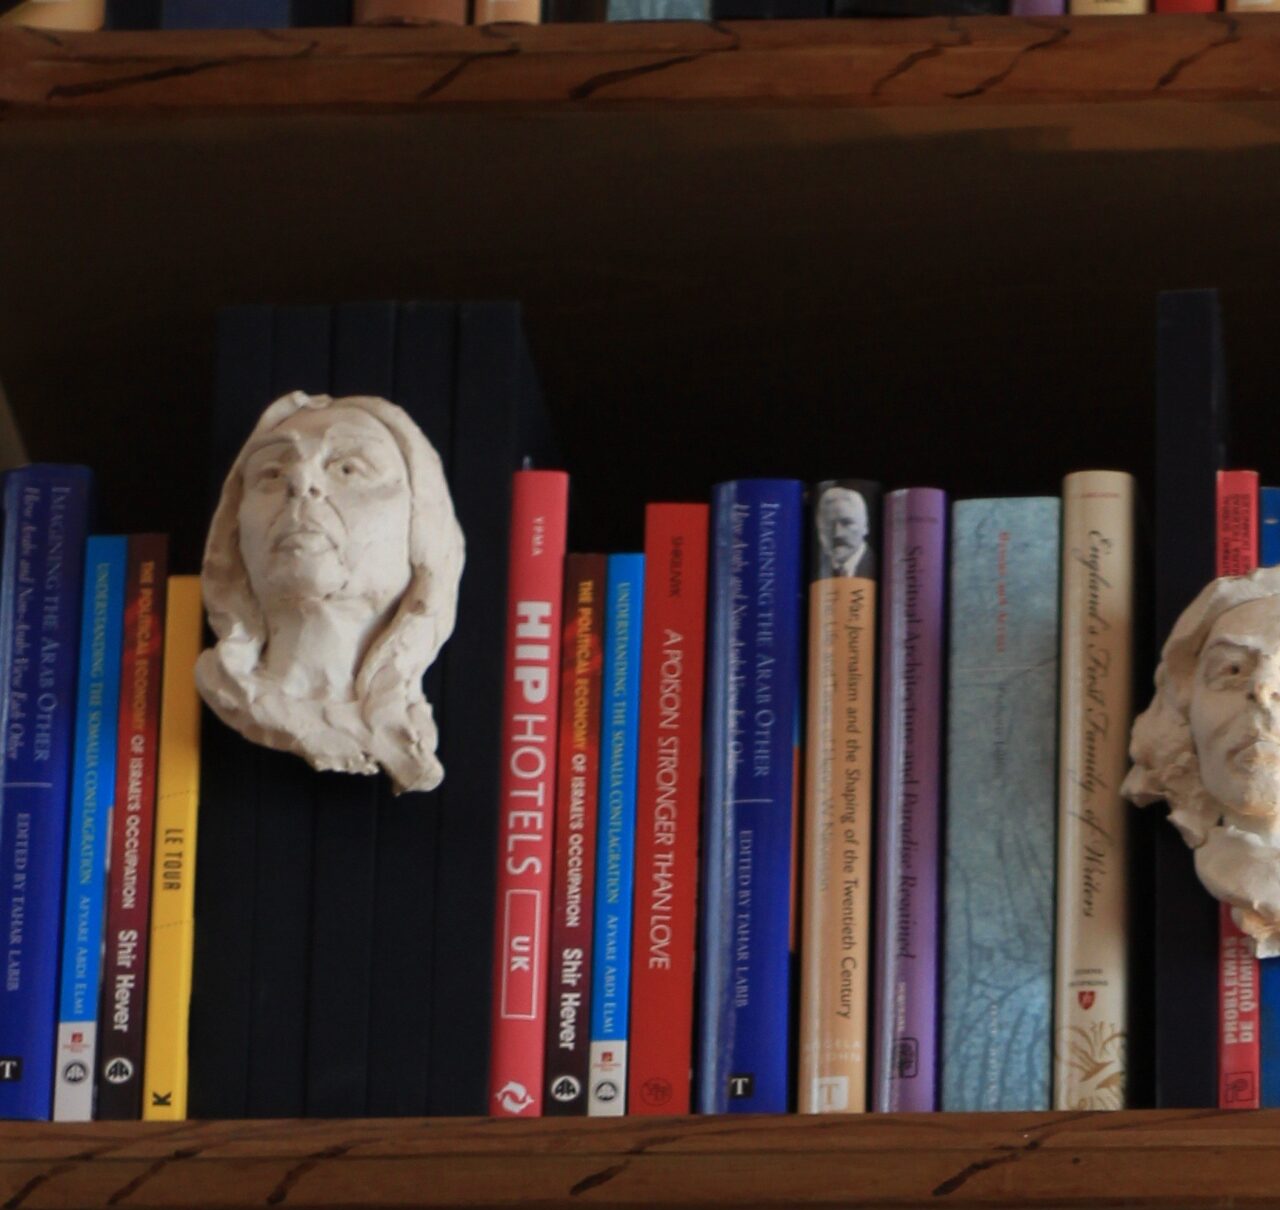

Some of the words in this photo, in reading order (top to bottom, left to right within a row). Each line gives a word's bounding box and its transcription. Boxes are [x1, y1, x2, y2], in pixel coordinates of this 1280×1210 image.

[846, 588, 865, 620] War,
[513, 600, 553, 704] HIP
[660, 629, 684, 648] A
[841, 625, 864, 703] Journalism
[656, 650, 683, 730] POISON
[846, 708, 863, 734] and
[844, 740, 863, 764] the
[506, 714, 548, 876] HOTELS
[652, 736, 681, 846] STRONGER
[839, 769, 863, 824] Shaping
[164, 829, 185, 845] LE
[841, 829, 860, 847] of
[841, 849, 859, 875] the
[162, 852, 184, 891] TOUR
[650, 852, 675, 911] THAN
[648, 915, 672, 970] LOVE
[838, 878, 860, 952] Twentieth
[116, 930, 139, 968] Shir
[509, 935, 532, 972] UK
[112, 974, 136, 1034] Hever
[834, 957, 858, 1021] Century
